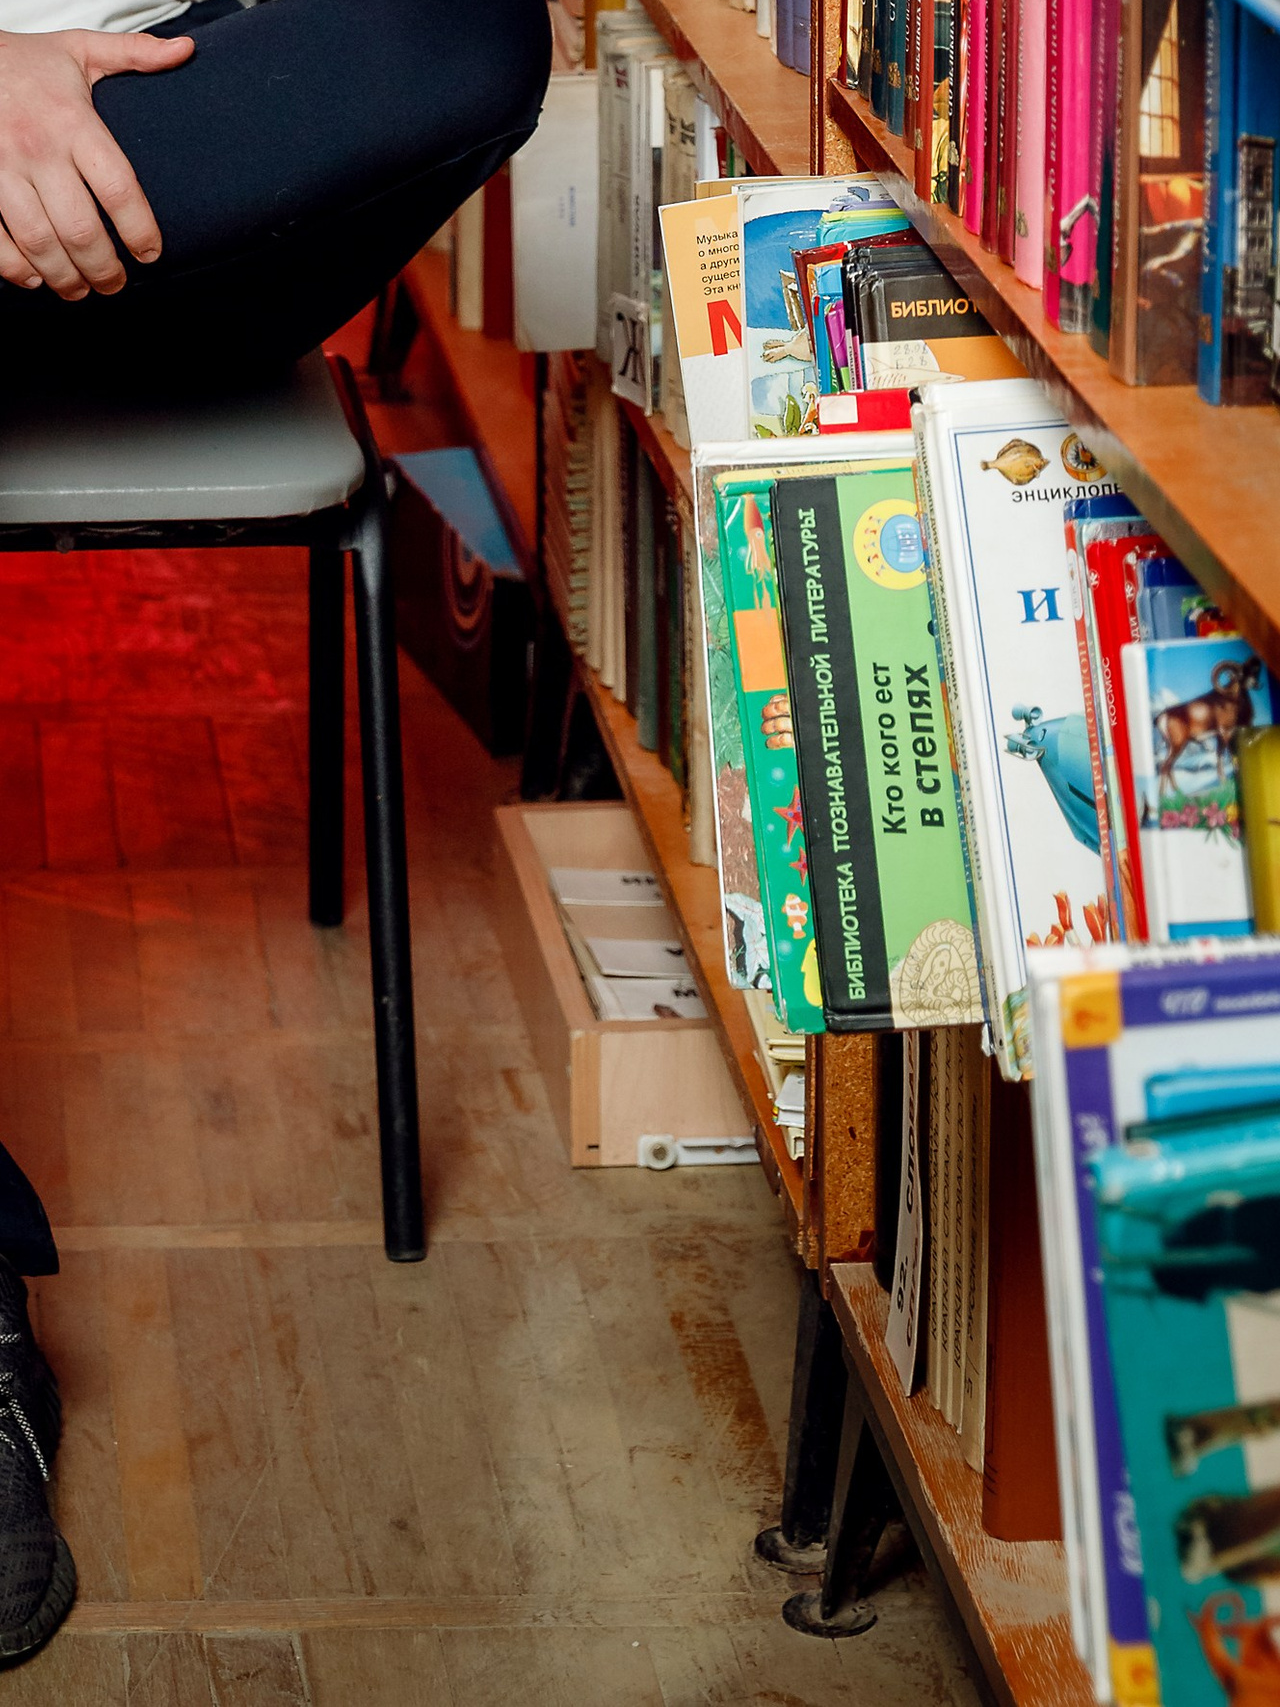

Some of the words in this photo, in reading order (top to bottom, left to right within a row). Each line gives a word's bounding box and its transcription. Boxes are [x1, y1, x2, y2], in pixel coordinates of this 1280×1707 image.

[913, 5, 923, 74] ВЕЛИКИХ
[1048, 62, 1059, 163] ВЕЛИКИХ
[696, 230, 739, 245] Музыка
[702, 285, 723, 297] Эта
[798, 506, 829, 644] ЛИТЕРАТУРЫ
[920, 432, 937, 546] ЭНЦИКЛОПЕДИЯ
[934, 548, 953, 658] ОКРУЖАЮЩЕГО
[949, 660, 959, 702] МИРА
[1017, 587, 1064, 624] И
[871, 661, 892, 704] ест
[1101, 655, 1118, 728] КОСМОС
[810, 653, 851, 853] ПОЗНАВАТЕЛЬНОЙ
[879, 713, 902, 777] кого
[903, 663, 942, 795] степях
[881, 785, 908, 835] Кто
[920, 807, 946, 827] в
[836, 862, 867, 1000] БИБЛИОТЕКА
[942, 1133, 951, 1238] СЛОВАРЬ
[955, 1150, 964, 1255] СЛОВАРЬ
[896, 1255, 909, 1314] 92.
[941, 1247, 950, 1353] КРАТКИЙ
[953, 1261, 963, 1369] КРАТКИЙ
